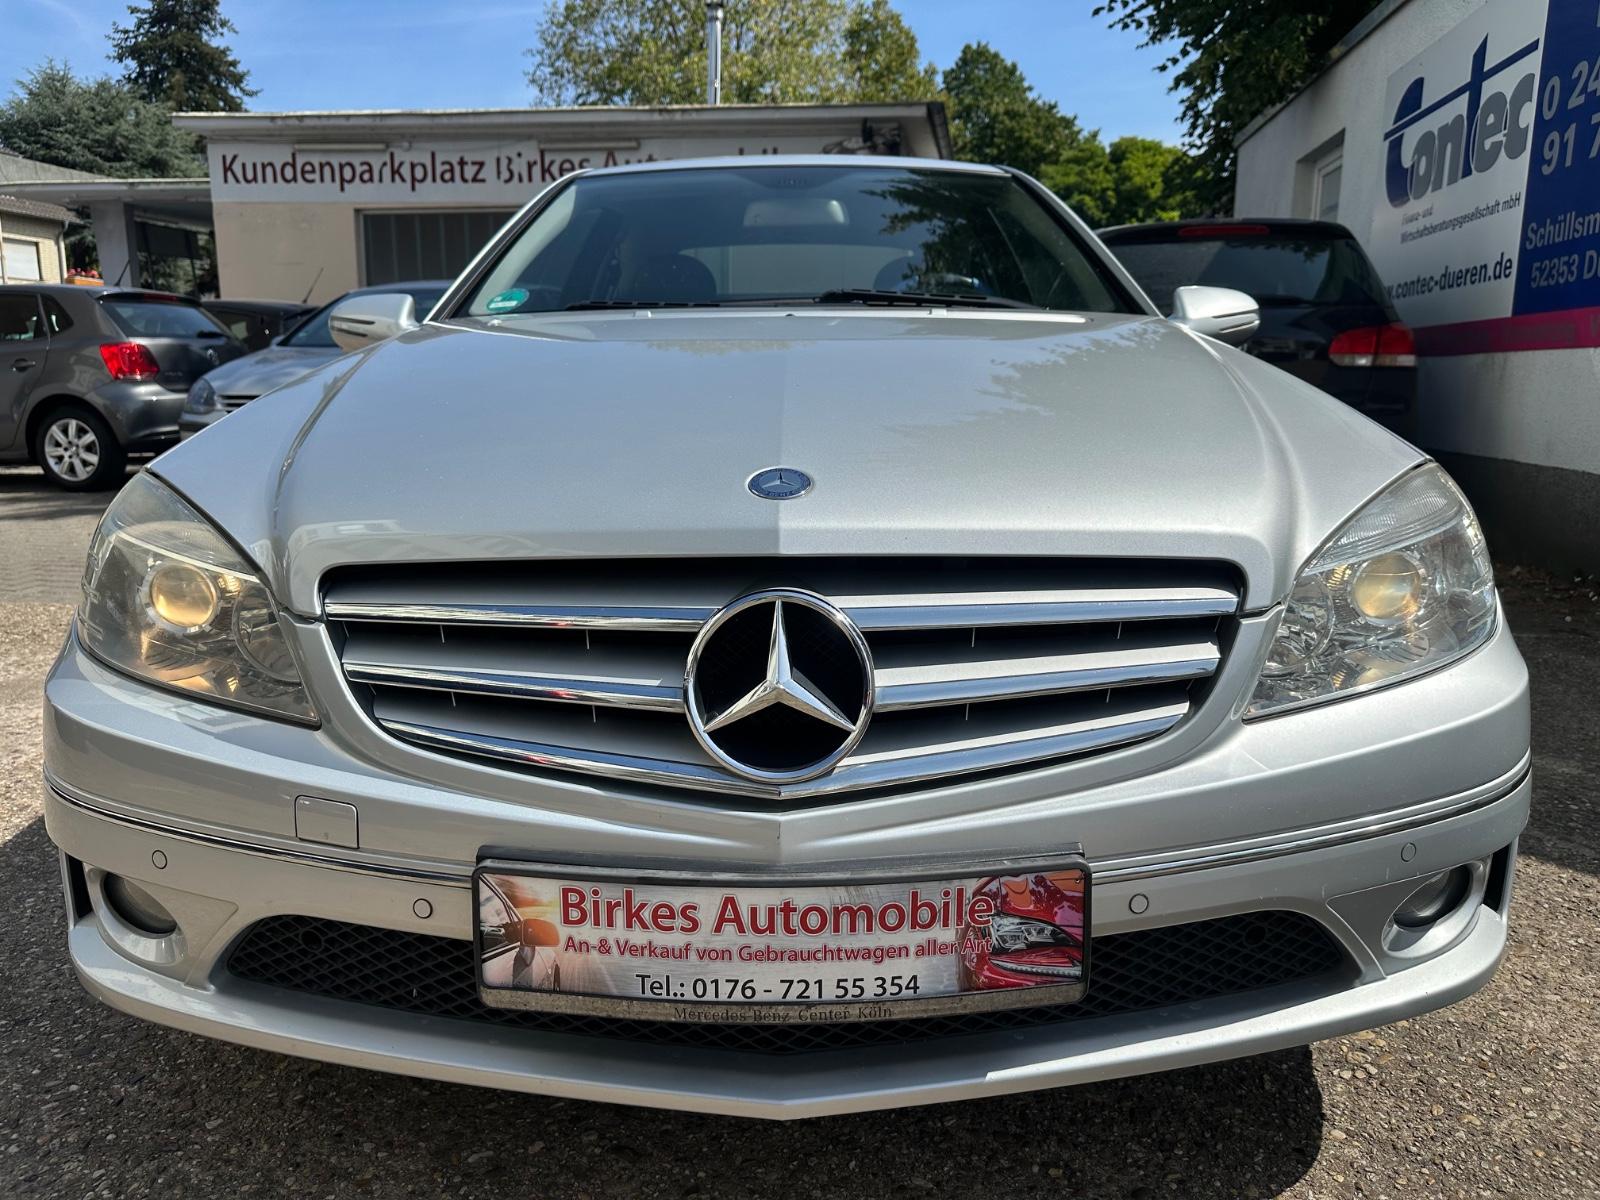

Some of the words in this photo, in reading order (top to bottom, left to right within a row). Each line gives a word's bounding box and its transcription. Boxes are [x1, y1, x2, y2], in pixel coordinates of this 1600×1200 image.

[1542, 75, 1560, 120] 0
[1541, 122, 1577, 176] 91
[221, 150, 487, 193] Kundenparkplatz
[1501, 192, 1522, 213] mbH
[1530, 253, 1579, 289] 52353
[1582, 248, 1600, 280] D
[560, 885, 701, 935] Birkes
[711, 885, 995, 937] Automobile
[615, 937, 692, 962] Verkauf
[695, 944, 733, 962] von
[738, 939, 910, 965] Gebrauchtwagen
[914, 937, 959, 959] aller
[960, 936, 994, 955] Art
[635, 973, 686, 998] Tel.:
[692, 977, 757, 1000] 0176
[779, 978, 824, 1000] 721
[834, 977, 865, 1000] 55
[873, 974, 920, 998] 354
[798, 1007, 850, 1022] Center
[857, 1005, 893, 1020] Köln
